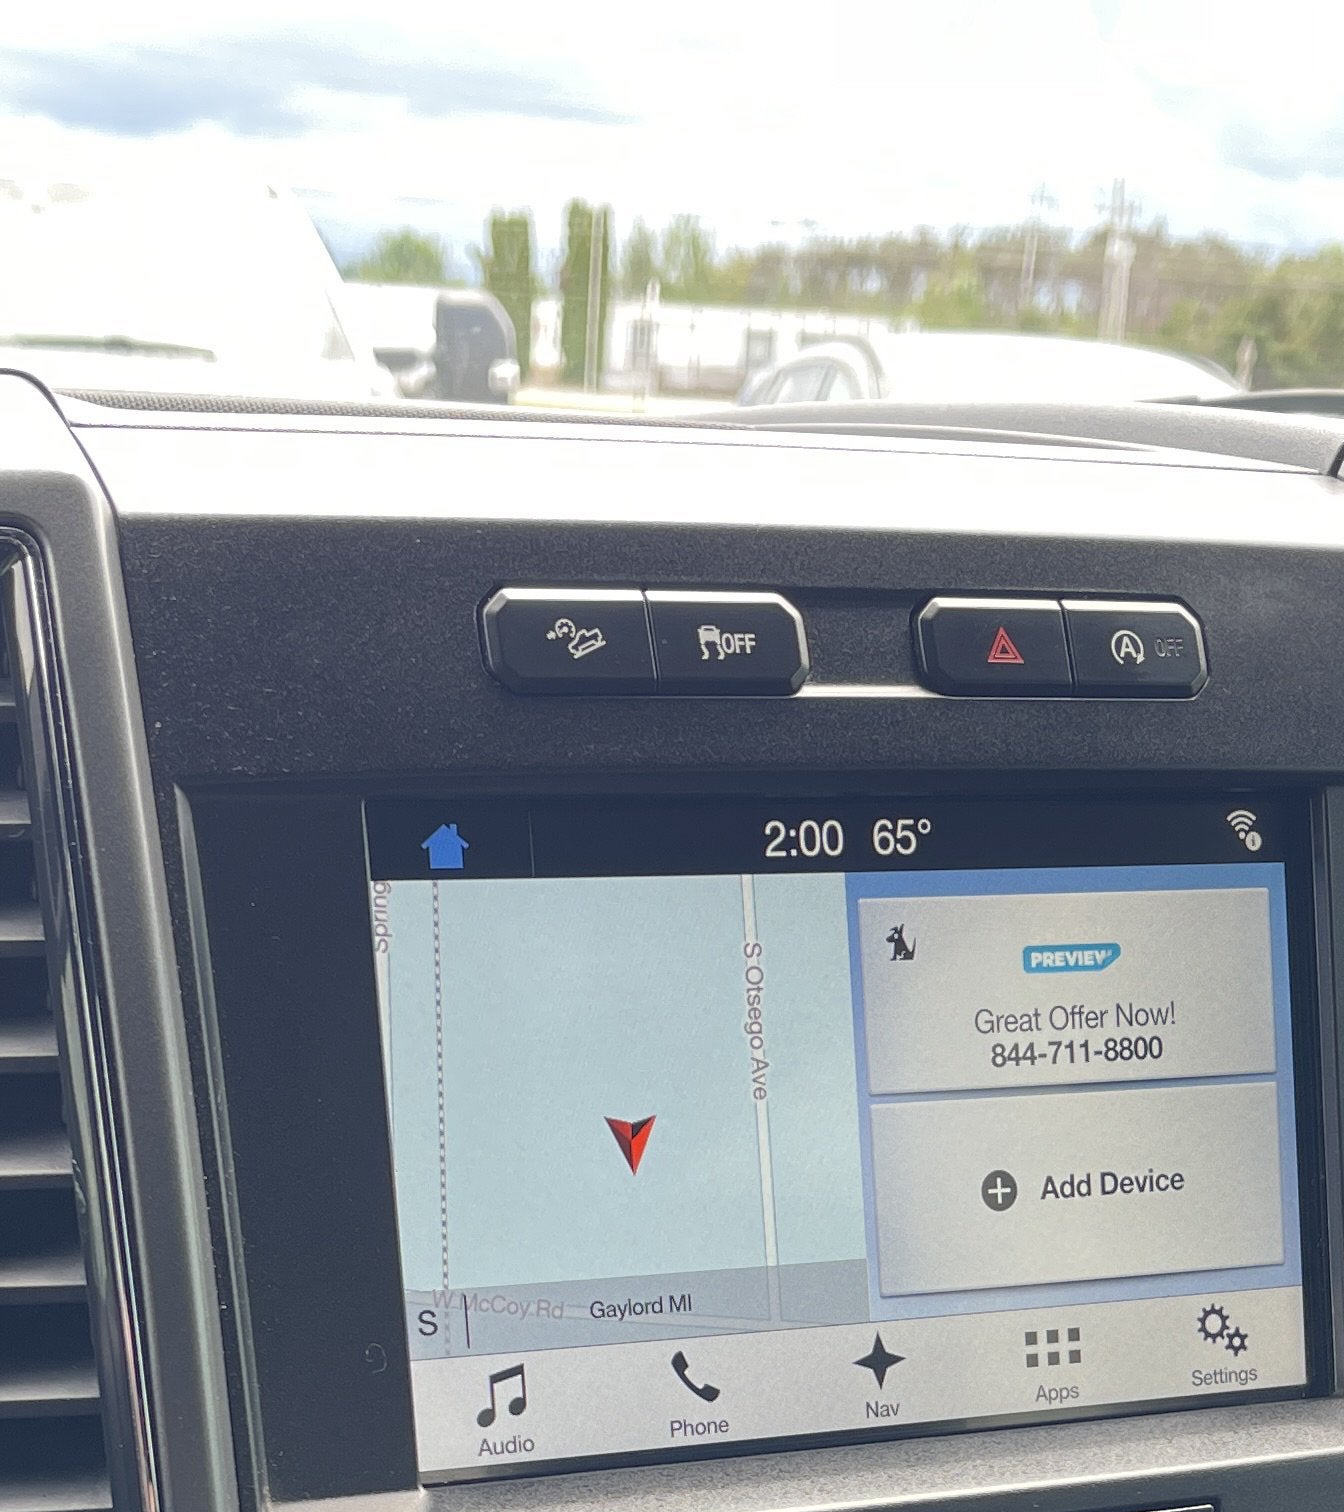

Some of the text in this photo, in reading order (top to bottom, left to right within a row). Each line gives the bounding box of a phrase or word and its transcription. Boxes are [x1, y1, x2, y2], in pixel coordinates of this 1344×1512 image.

[721, 632, 757, 655] OFF
[764, 819, 845, 858] 2:00
[743, 942, 770, 1101] S Otsego Ave
[973, 1001, 1177, 1036] Great Offer Now!
[990, 1035, 1164, 1068] 844-711-8800
[1040, 1167, 1185, 1201] Add Device
[431, 1288, 455, 1310] W
[535, 1298, 565, 1320] Rd
[589, 1294, 693, 1323] Gaylord MI
[417, 1308, 439, 1337] S
[1191, 1365, 1259, 1389] Settings
[1034, 1382, 1081, 1405] Apps
[864, 1400, 901, 1420] Nav
[669, 1416, 731, 1439] Phone
[477, 1435, 536, 1458] Audio
